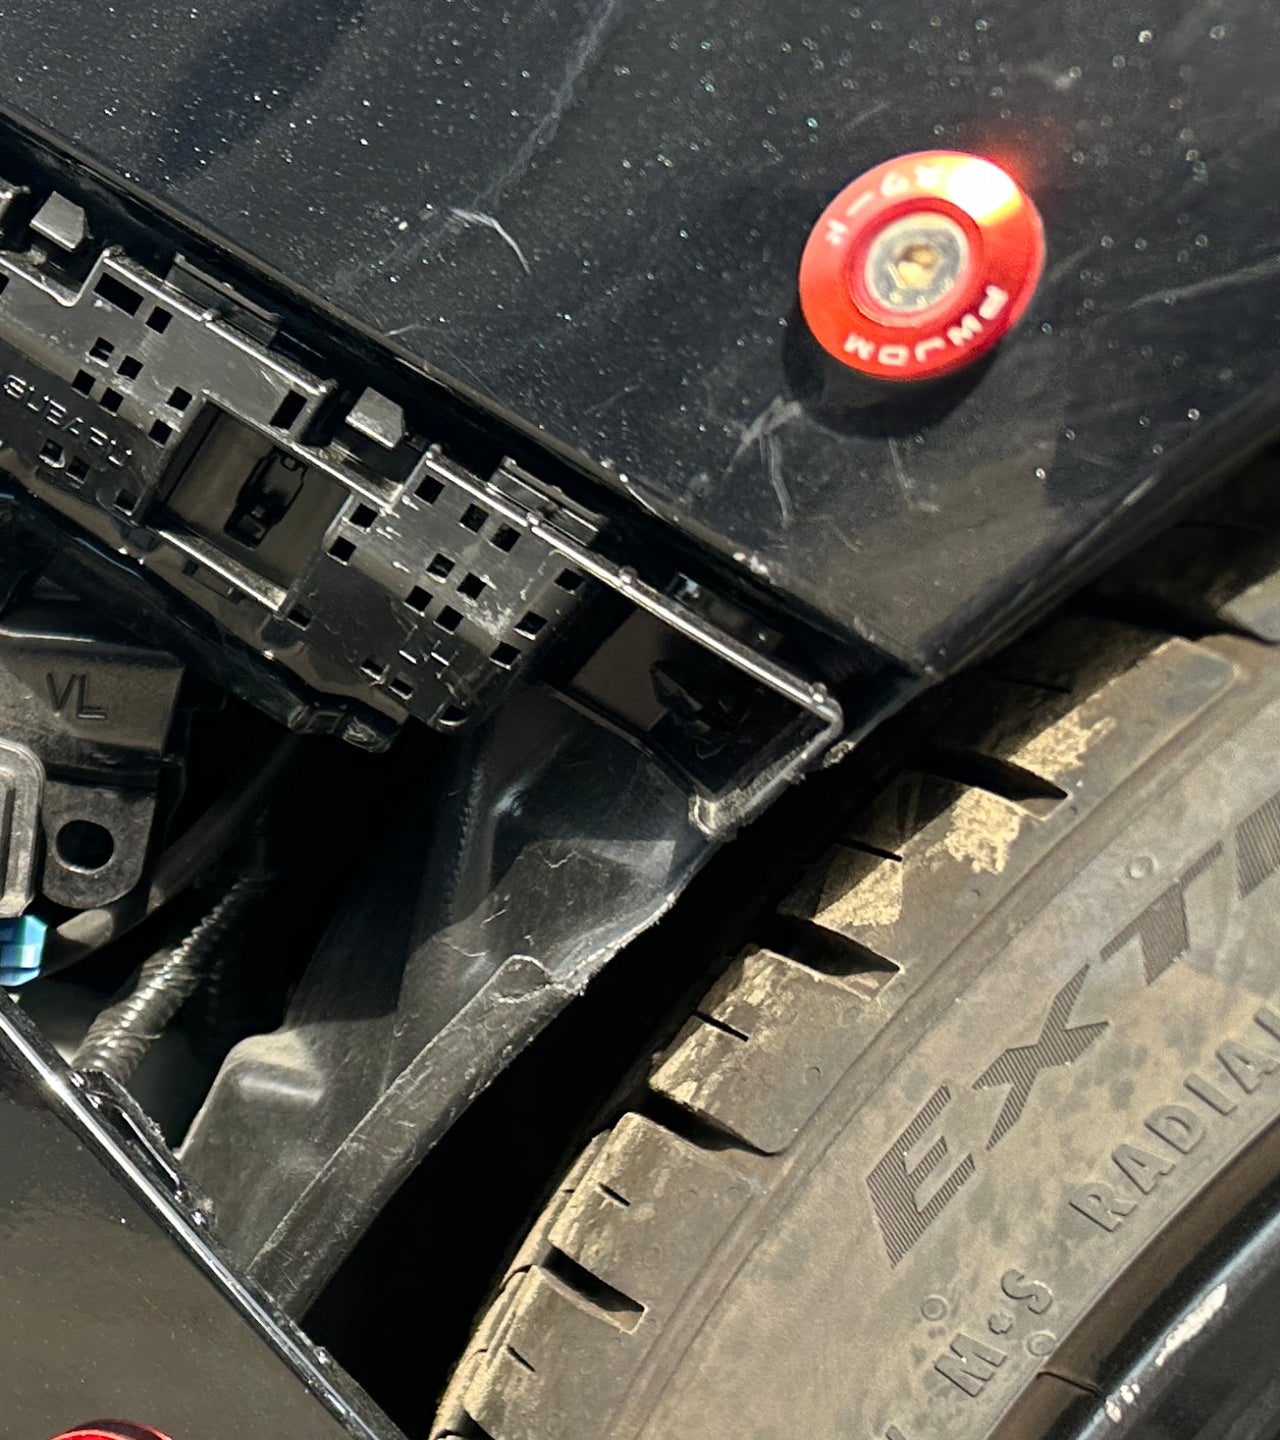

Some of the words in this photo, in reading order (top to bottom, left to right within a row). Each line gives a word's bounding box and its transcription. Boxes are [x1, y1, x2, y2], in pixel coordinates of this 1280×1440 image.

[843, 284, 1009, 367] PWJDM
[3, 374, 133, 469] SUBARU
[45, 671, 108, 721] VL
